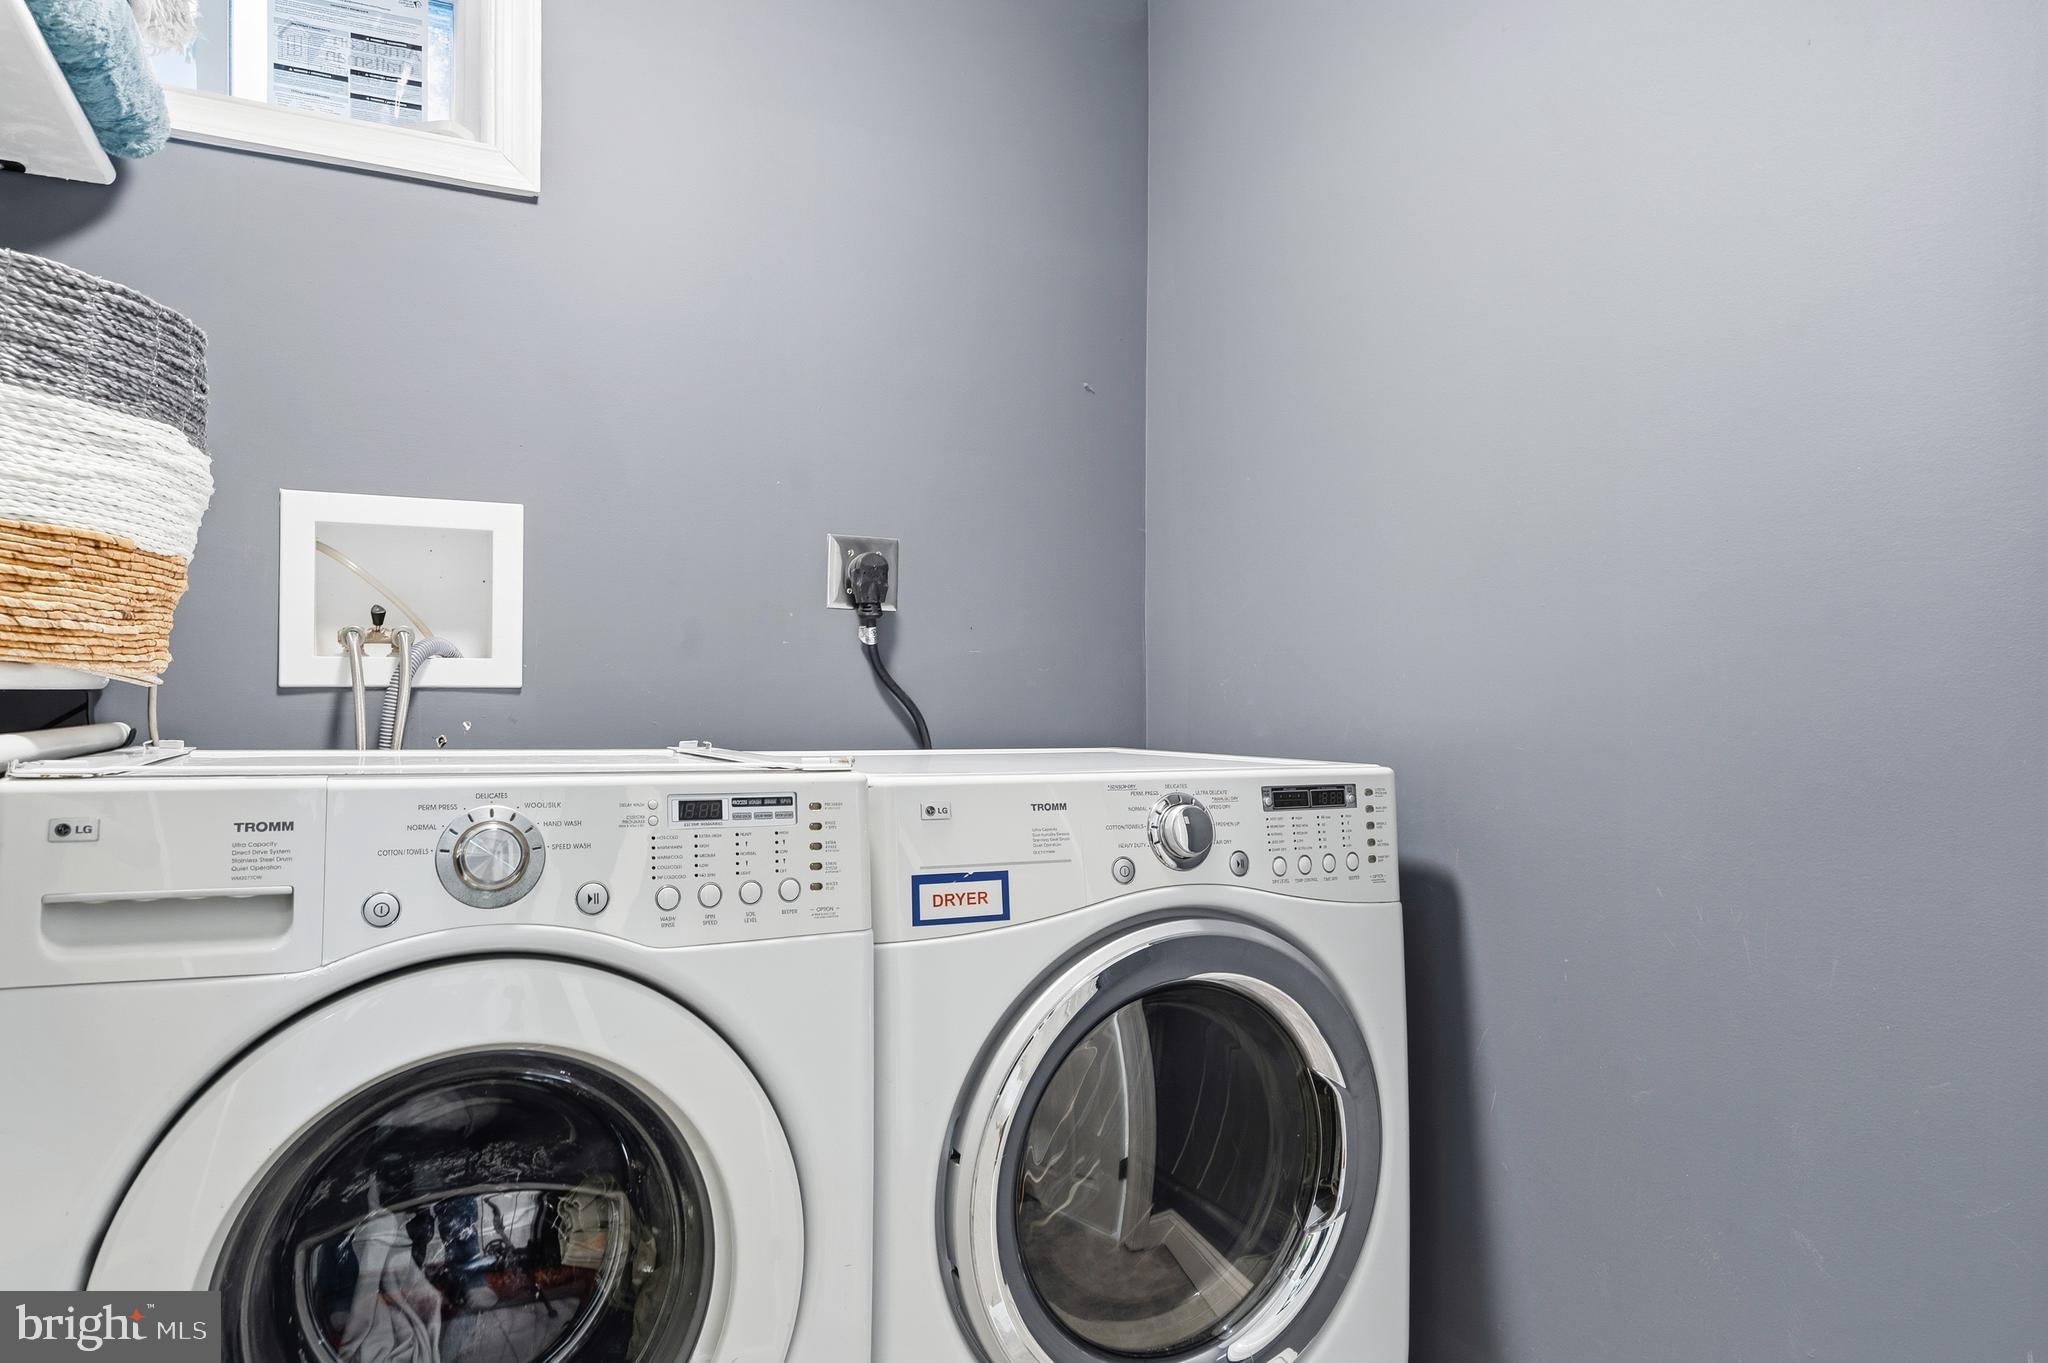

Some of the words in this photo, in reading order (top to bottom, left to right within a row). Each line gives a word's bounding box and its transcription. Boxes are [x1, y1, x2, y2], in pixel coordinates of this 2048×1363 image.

[475, 792, 508, 800] DELICATES
[438, 803, 458, 811] PRESS
[938, 807, 948, 815] LG
[1031, 802, 1068, 812] TROMM
[75, 825, 93, 834] LG
[233, 821, 295, 833] TROMM
[406, 823, 437, 831] NORMAL
[248, 841, 278, 849] Capacity
[269, 848, 291, 856] System
[932, 891, 989, 908] DRYER
